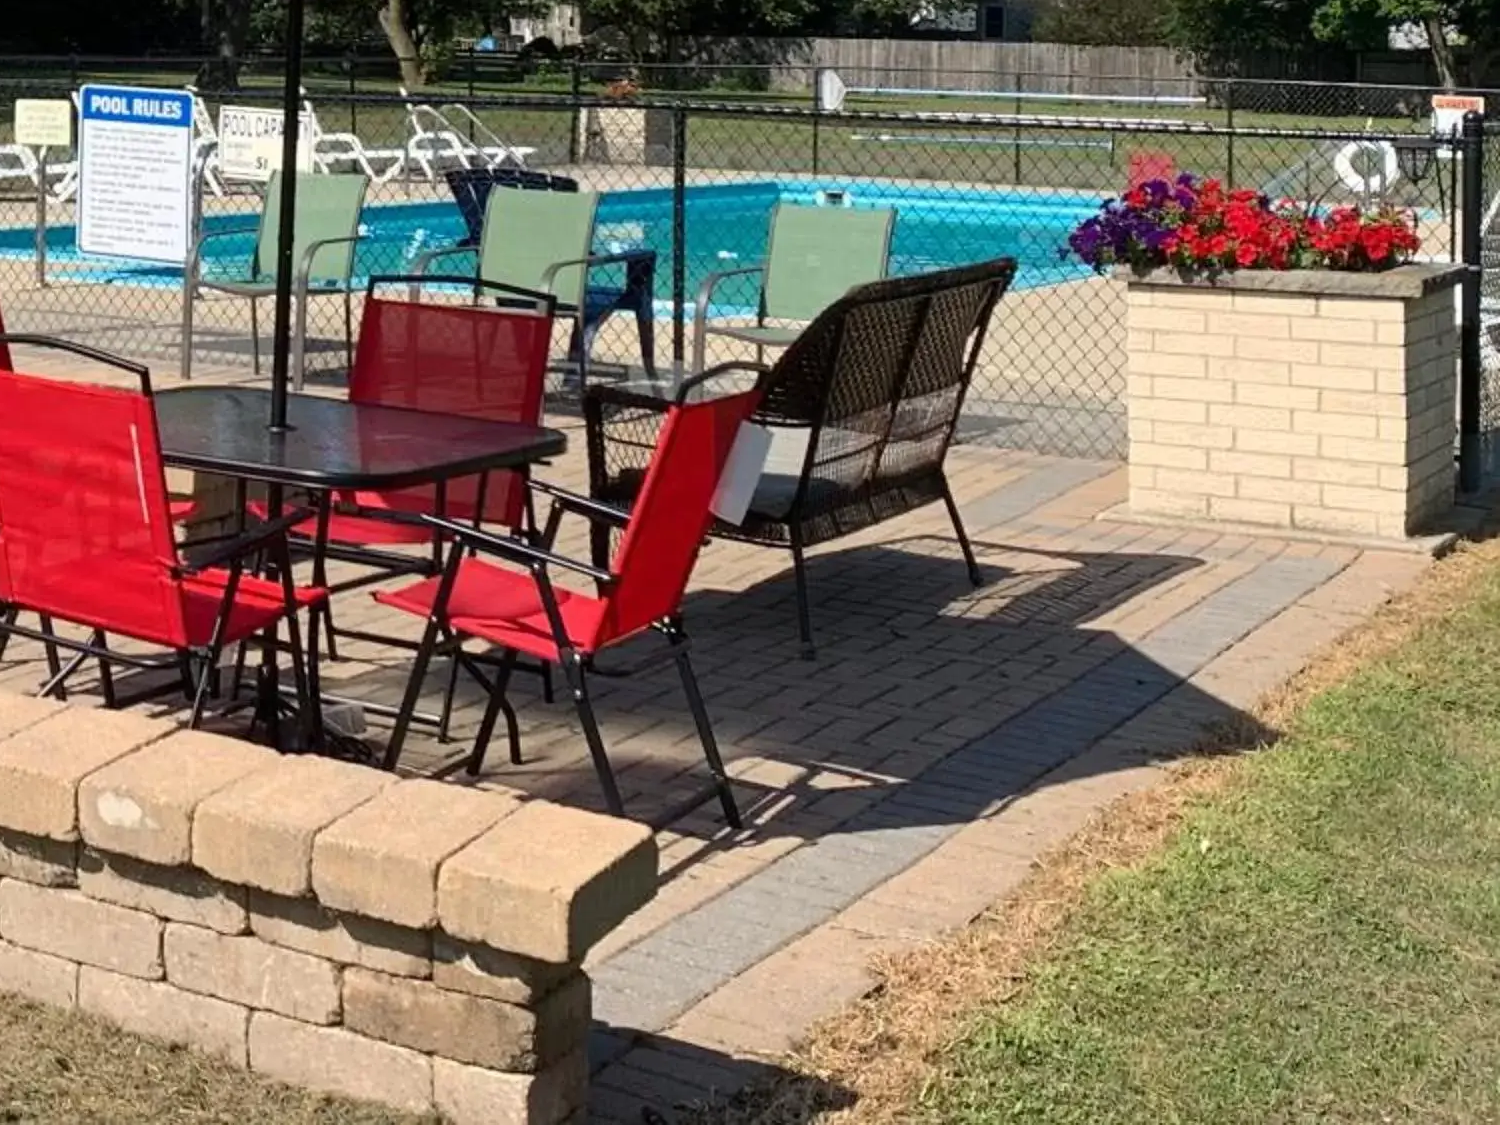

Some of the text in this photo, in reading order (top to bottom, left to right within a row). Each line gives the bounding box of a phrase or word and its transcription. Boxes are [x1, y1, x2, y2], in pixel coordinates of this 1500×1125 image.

[91, 95, 182, 120] POOL RULES
[223, 114, 252, 136] POOL
